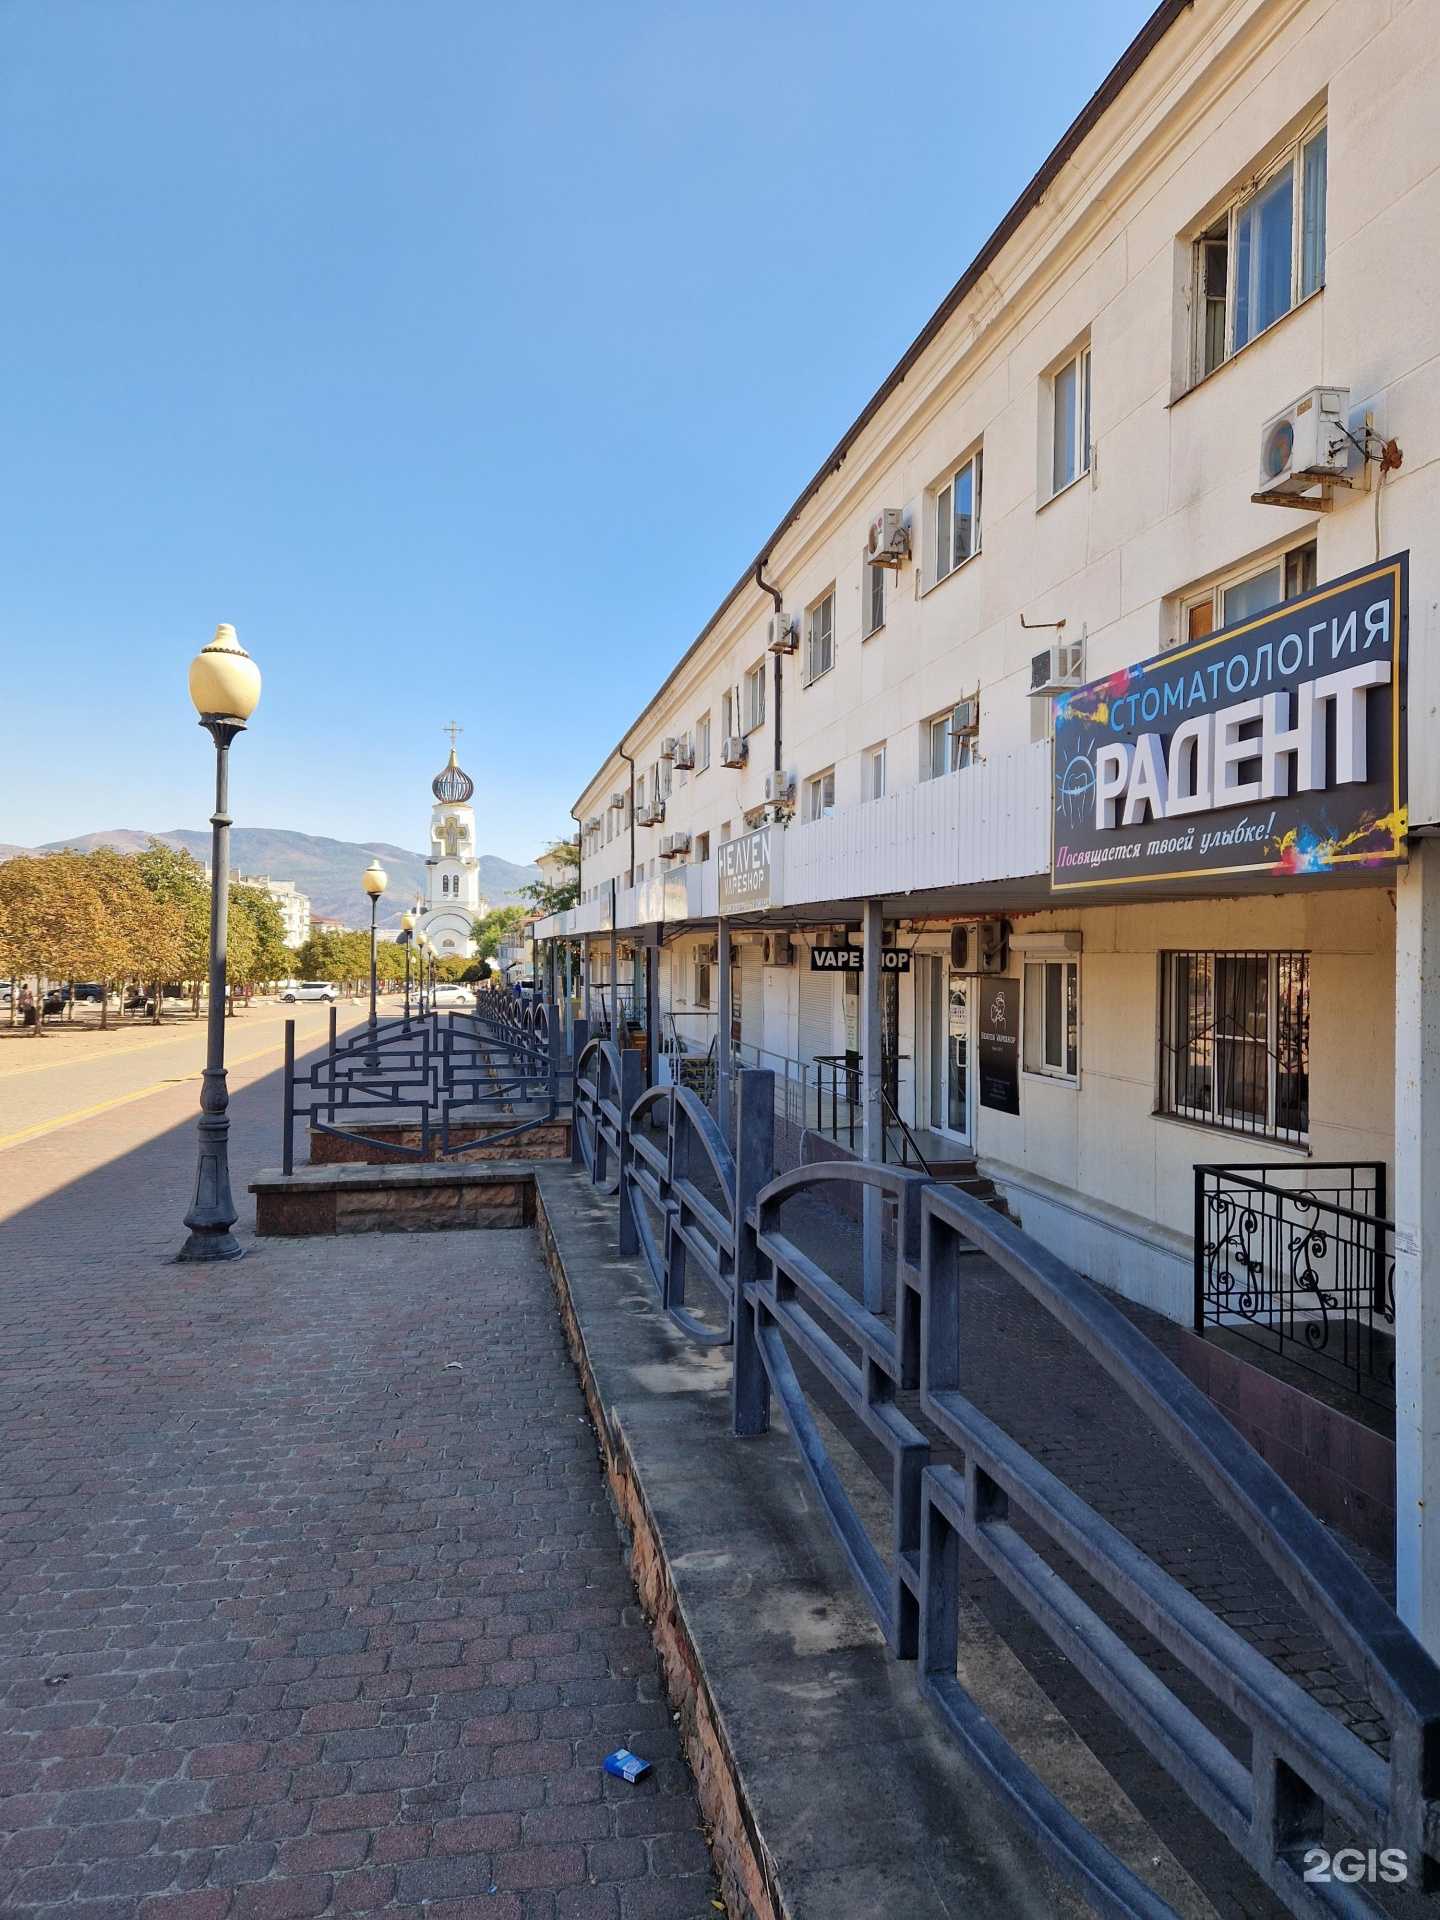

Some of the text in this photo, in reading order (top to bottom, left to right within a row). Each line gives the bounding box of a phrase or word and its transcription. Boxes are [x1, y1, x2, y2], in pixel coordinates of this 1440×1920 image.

[1110, 599, 1391, 732] СТОМАТОЛОГИЯ
[1095, 660, 1392, 830] РАДЕНТ
[719, 832, 770, 878] HEAVEN
[1056, 811, 1277, 868] Посвящается твоей улыбке!
[813, 950, 860, 967] VAPE
